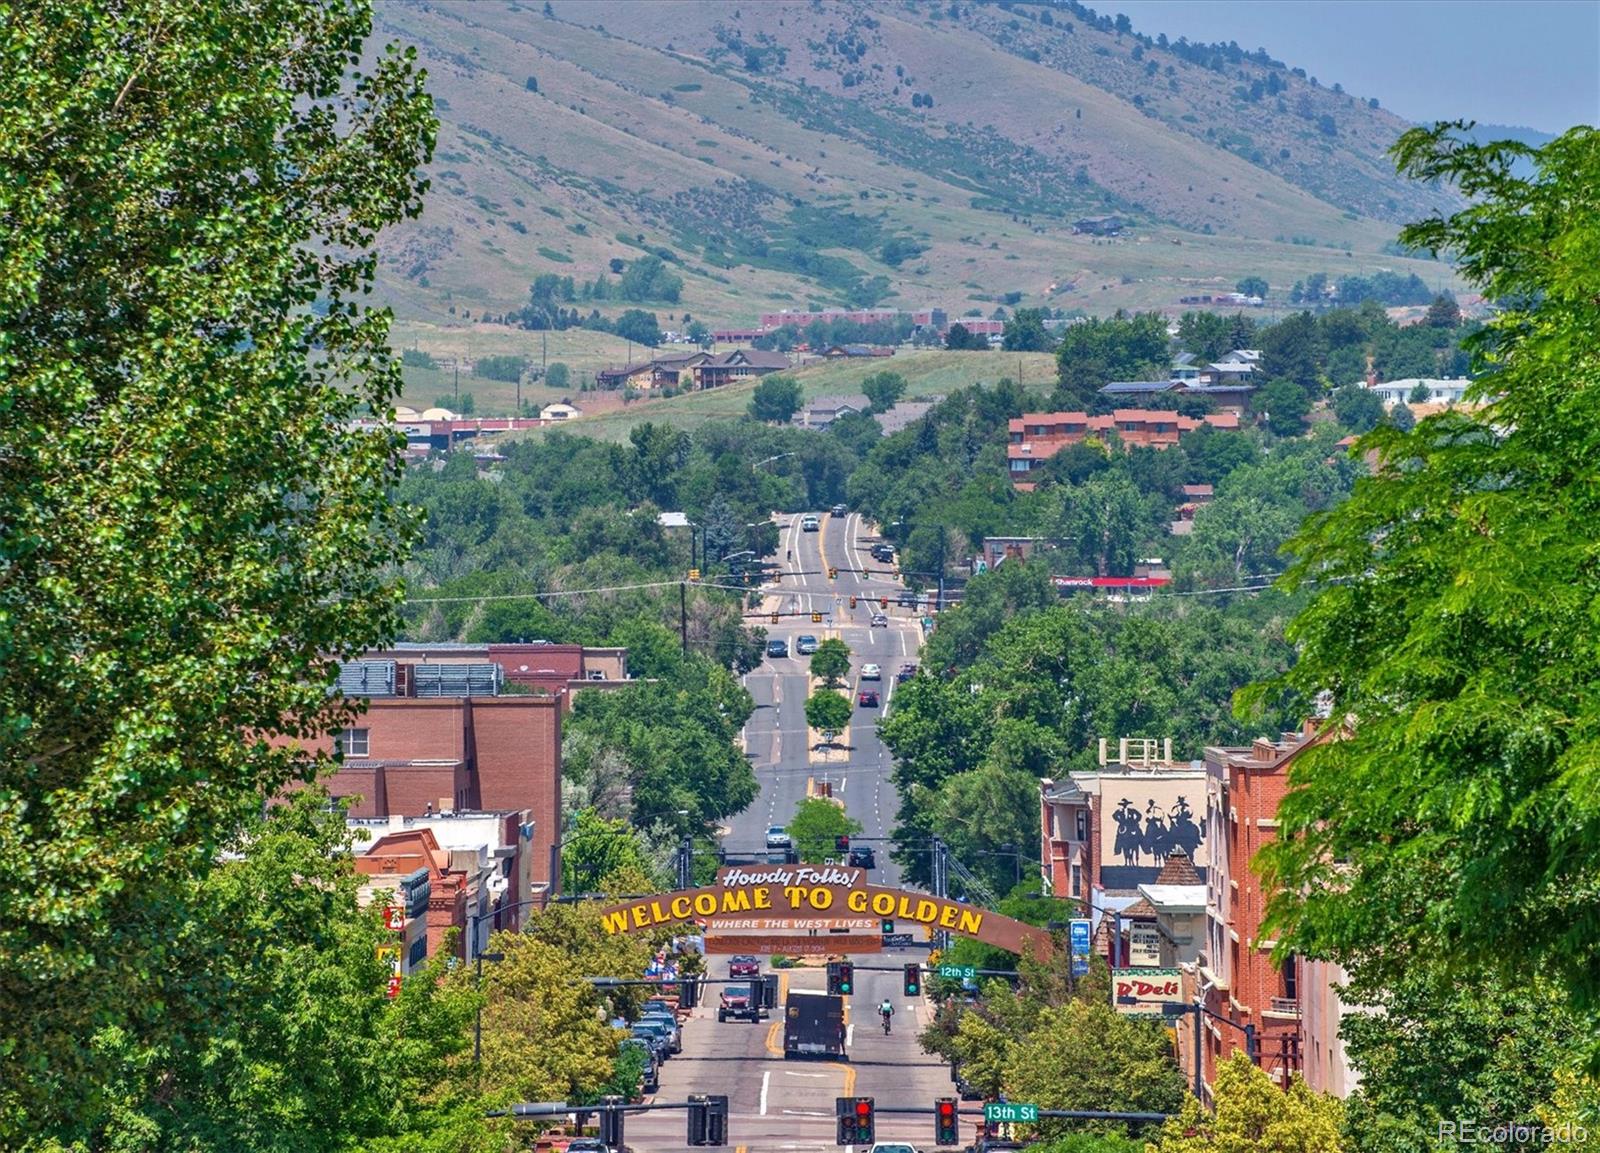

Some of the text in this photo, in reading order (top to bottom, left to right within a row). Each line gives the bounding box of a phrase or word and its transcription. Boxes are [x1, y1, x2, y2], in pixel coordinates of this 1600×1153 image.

[1055, 578, 1093, 586] Shamrock
[723, 867, 860, 888] Howdy Folks!
[602, 886, 984, 936] WELCOME TO GOLDEN
[711, 919, 873, 929] WHERE THE WEST LIVES
[940, 967, 975, 977] 12th St
[987, 1106, 1035, 1120] 13th St
